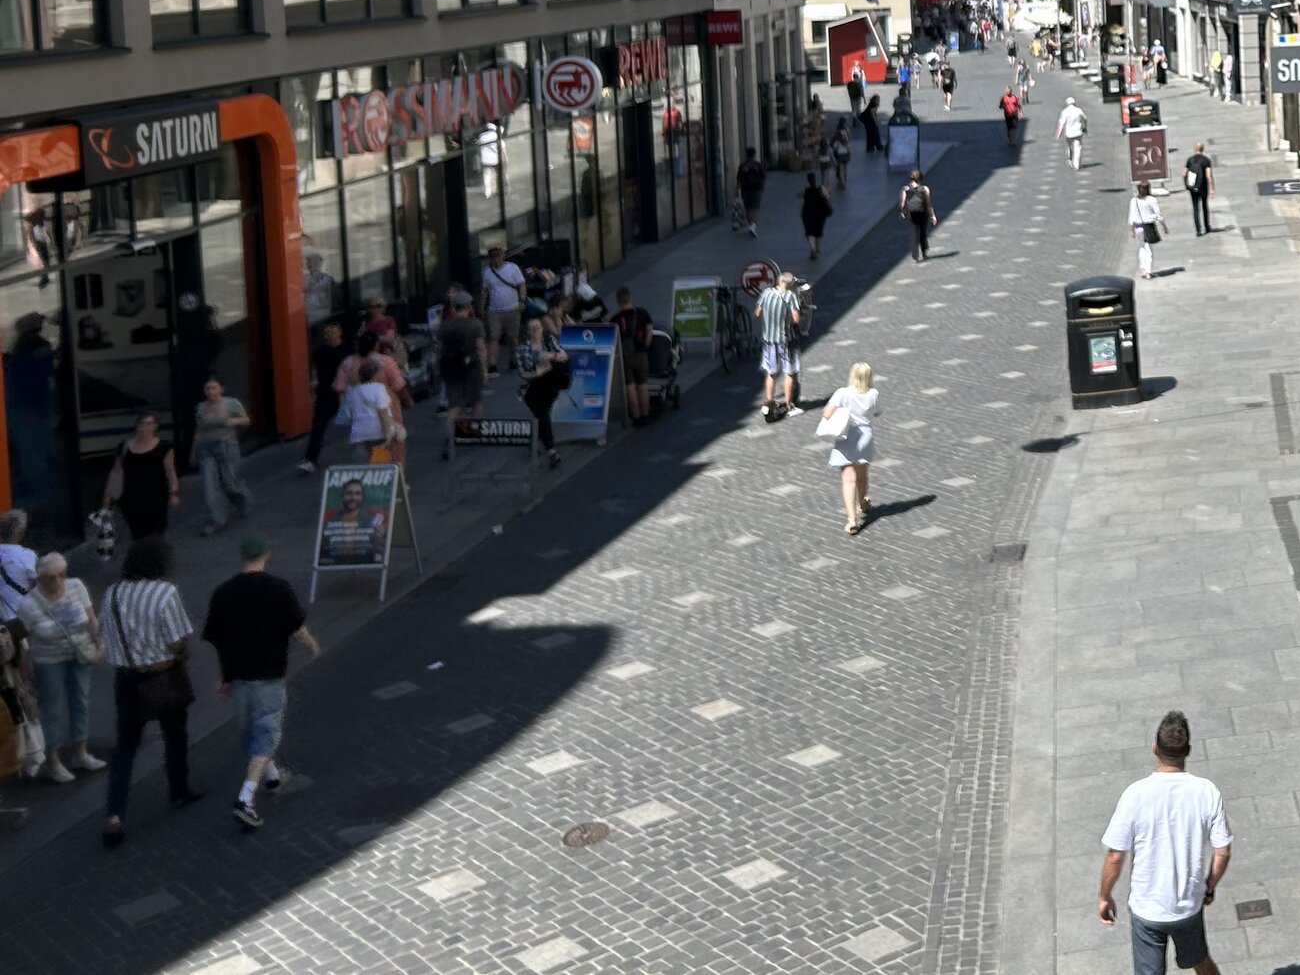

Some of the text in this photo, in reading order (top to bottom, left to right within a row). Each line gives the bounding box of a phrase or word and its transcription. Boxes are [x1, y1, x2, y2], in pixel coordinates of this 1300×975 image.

[708, 22, 740, 34] REWE
[617, 36, 668, 87] REWE
[333, 67, 516, 159] ROSSMANN
[136, 110, 218, 165] SATURN
[1134, 146, 1162, 165] 50
[480, 420, 531, 436] SATURN
